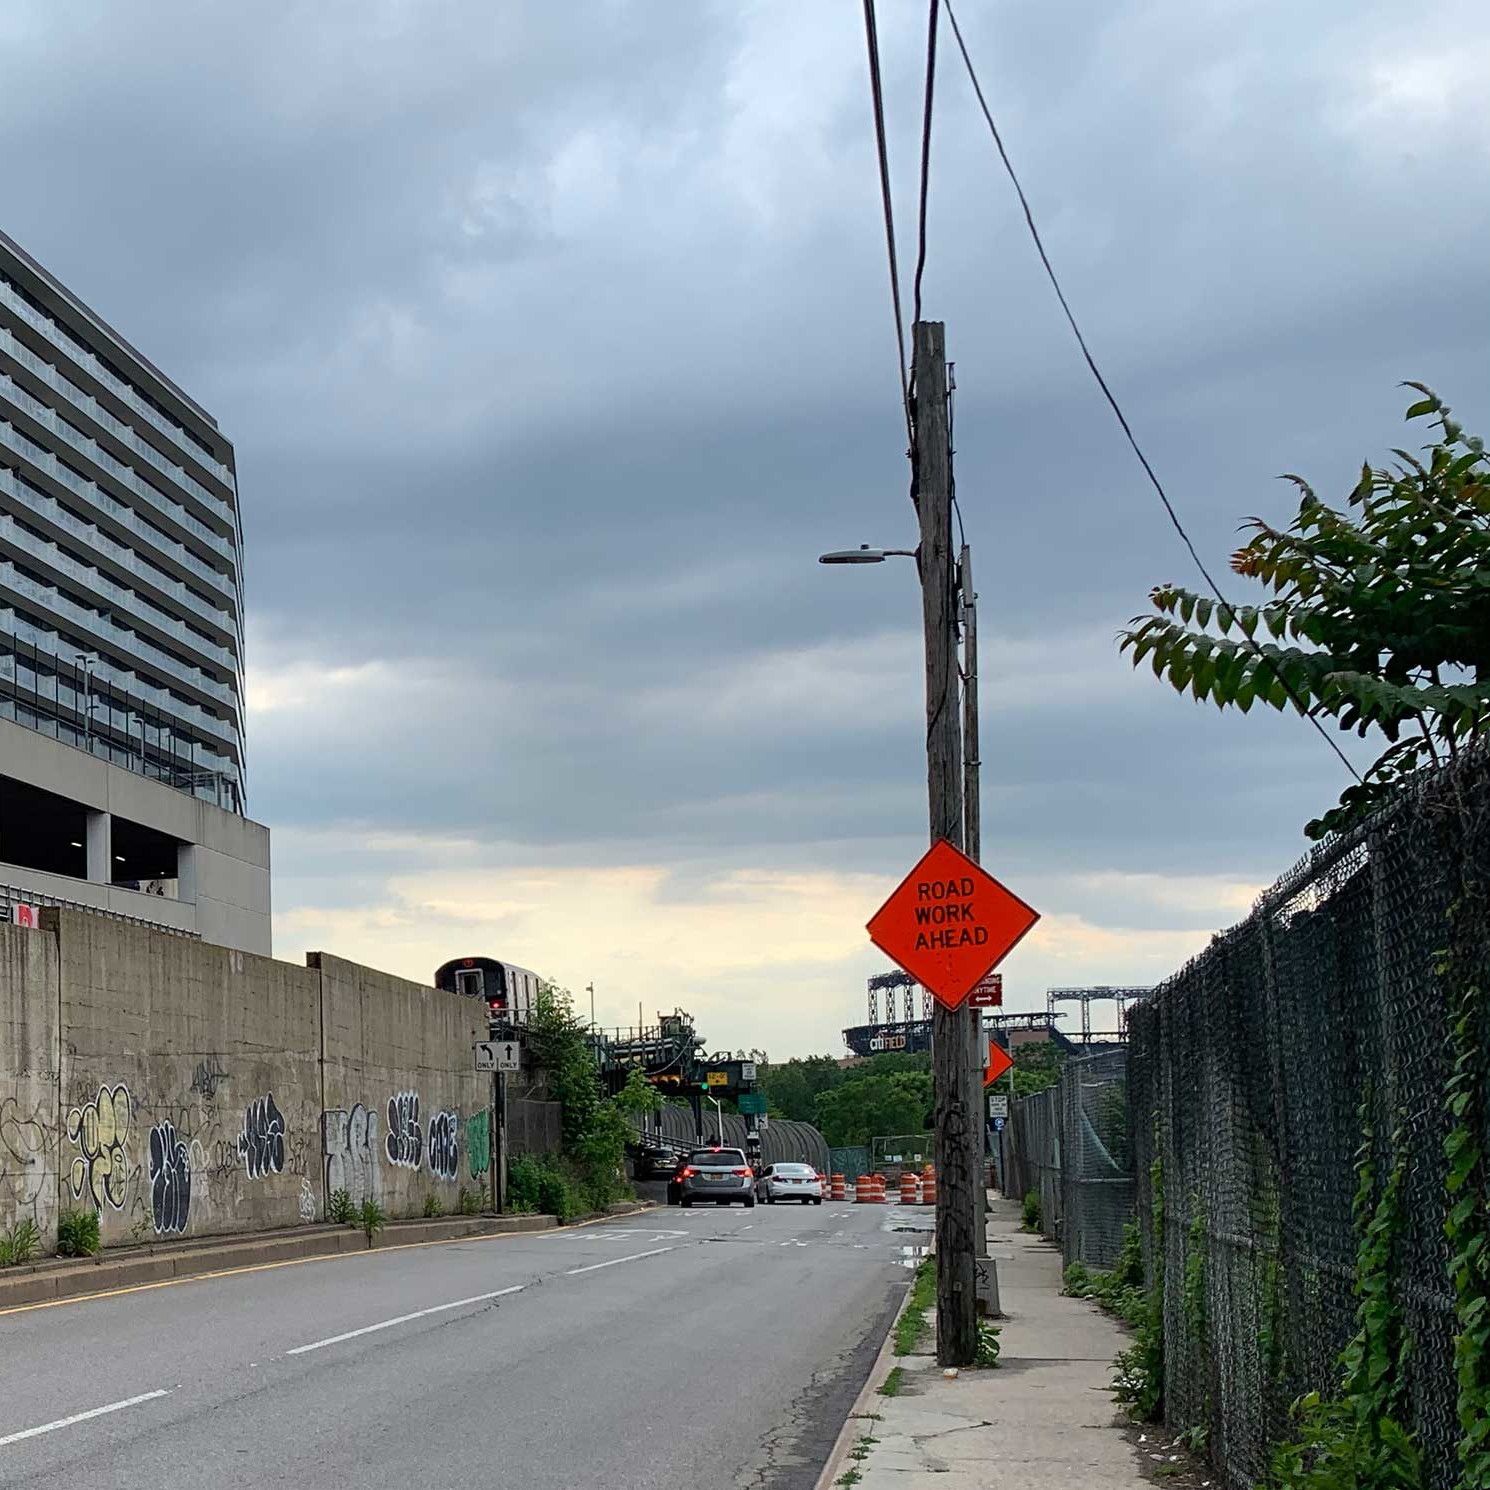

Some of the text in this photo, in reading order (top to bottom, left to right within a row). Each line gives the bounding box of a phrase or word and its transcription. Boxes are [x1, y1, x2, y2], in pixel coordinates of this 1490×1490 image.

[917, 877, 975, 901] ROAD
[915, 903, 974, 925] WORK
[914, 926, 989, 951] AHEAD
